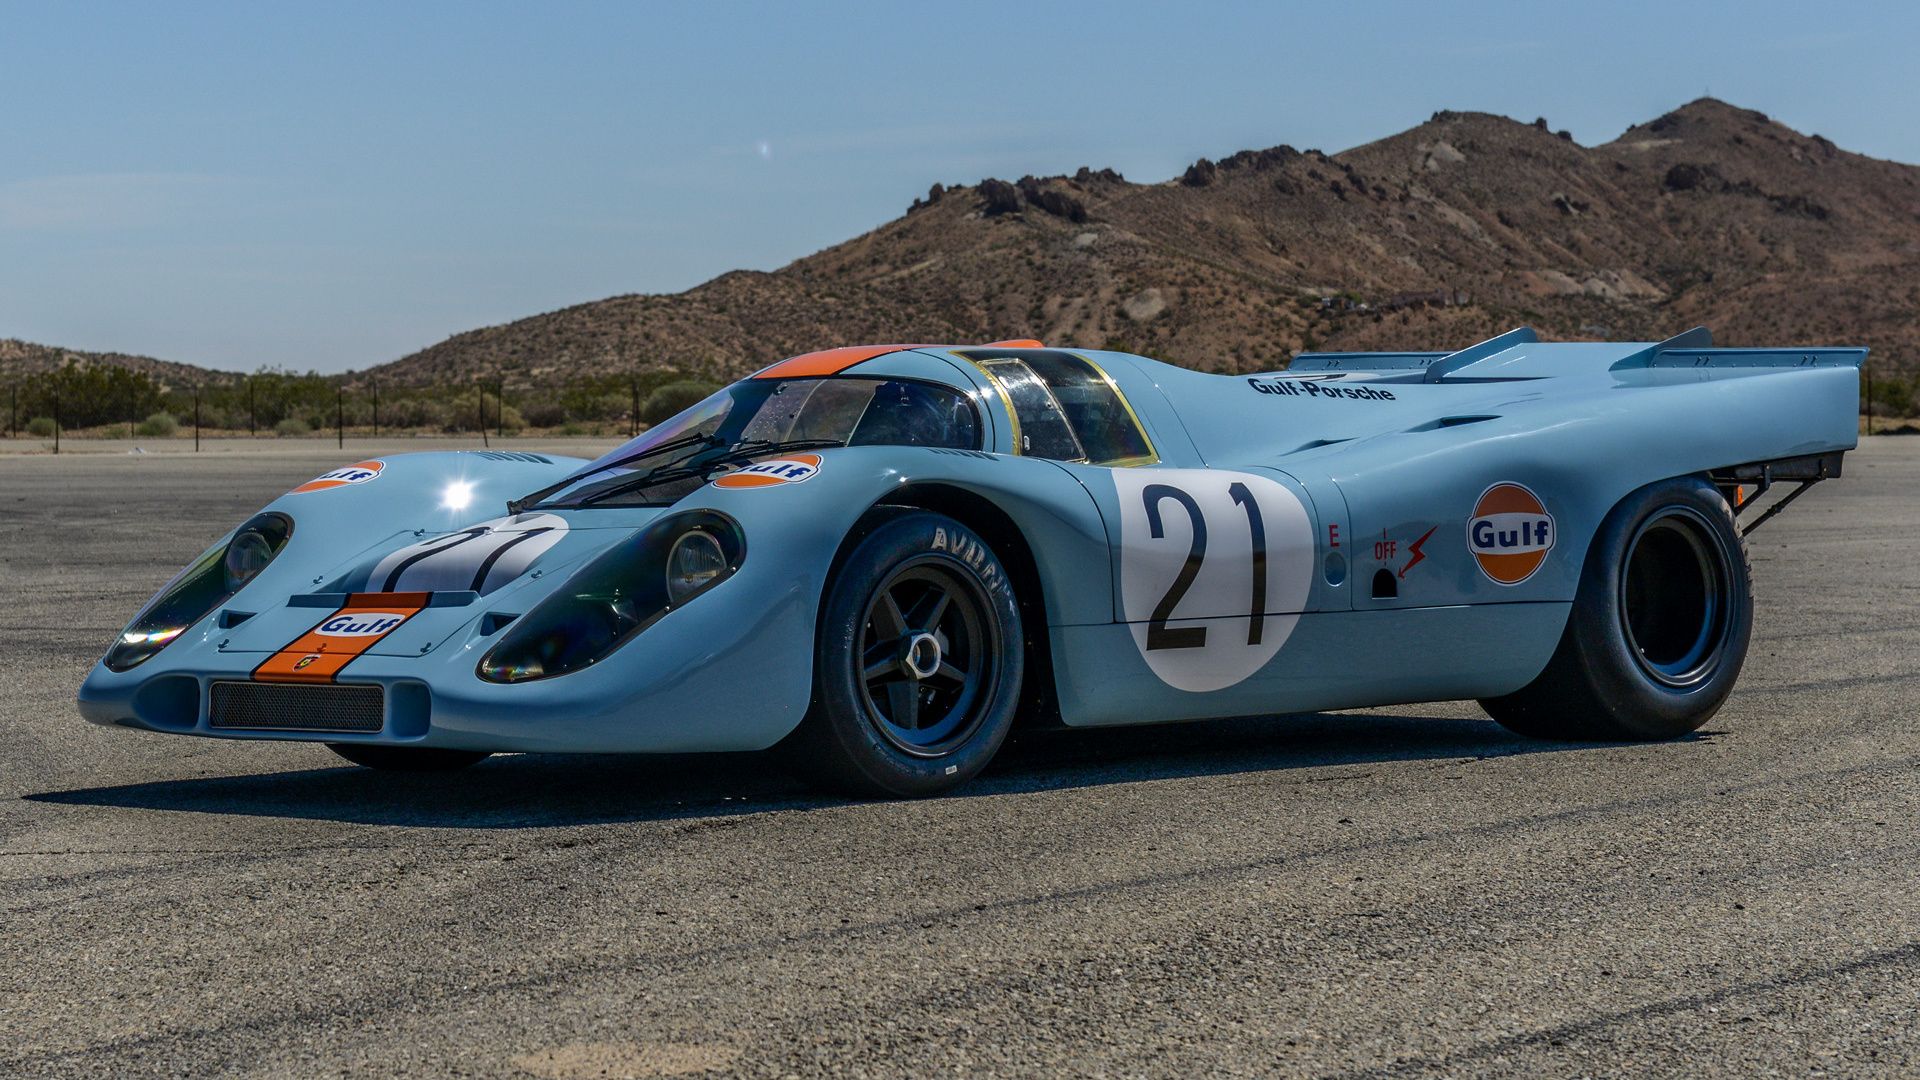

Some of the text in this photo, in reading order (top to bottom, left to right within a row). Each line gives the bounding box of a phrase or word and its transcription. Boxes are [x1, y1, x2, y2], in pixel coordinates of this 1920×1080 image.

[1247, 378, 1396, 400] Gulf-Porsche
[319, 470, 372, 481] ulf
[738, 464, 811, 478] ulf
[1328, 524, 1340, 547] E
[1472, 520, 1549, 548] Gulf
[1374, 541, 1396, 561] OFF
[1142, 482, 1266, 651] 21
[320, 616, 401, 633] Gulf
